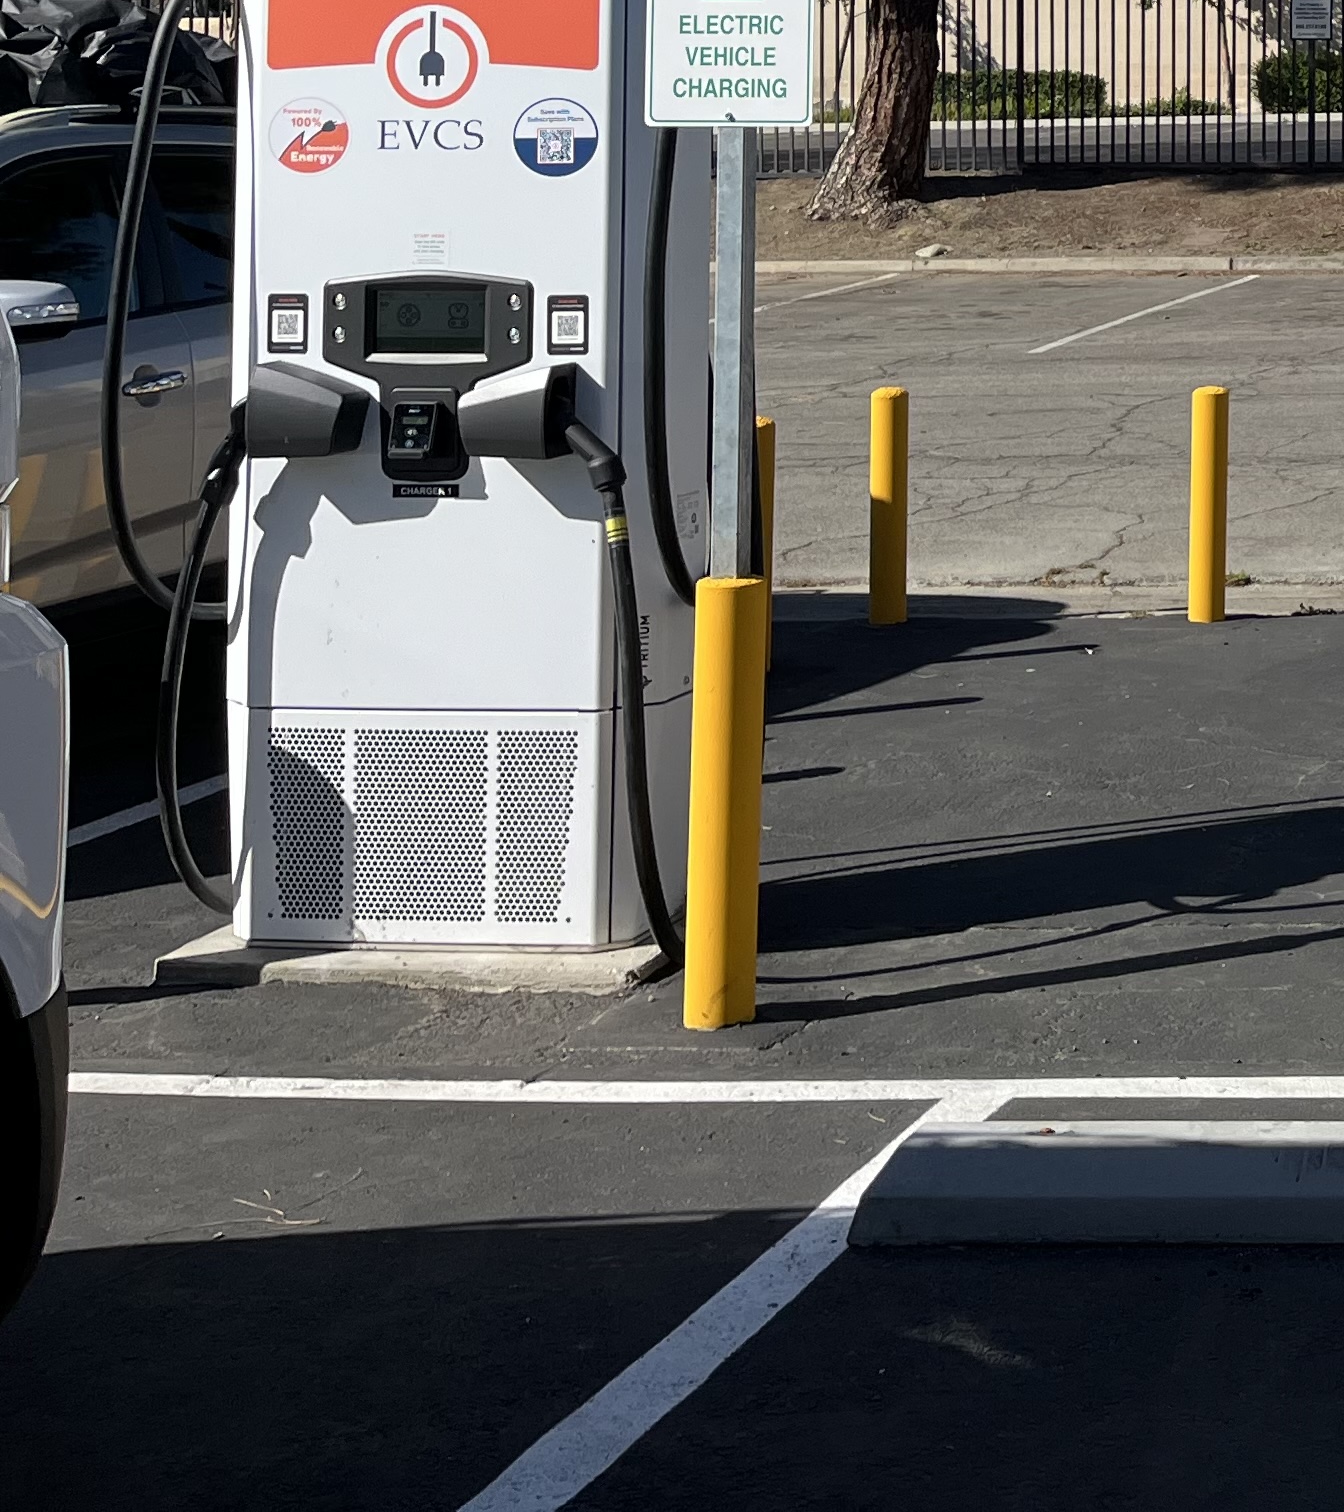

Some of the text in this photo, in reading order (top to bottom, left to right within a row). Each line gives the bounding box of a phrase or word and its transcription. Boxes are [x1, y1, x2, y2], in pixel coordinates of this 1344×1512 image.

[679, 14, 785, 35] ELECTRIC
[685, 46, 776, 66] VEHICLE
[672, 78, 787, 98] CHARGING
[291, 116, 322, 128] 100%
[376, 119, 484, 150] EVCS
[290, 150, 335, 165] Energy
[400, 486, 453, 496] CHARGER 1
